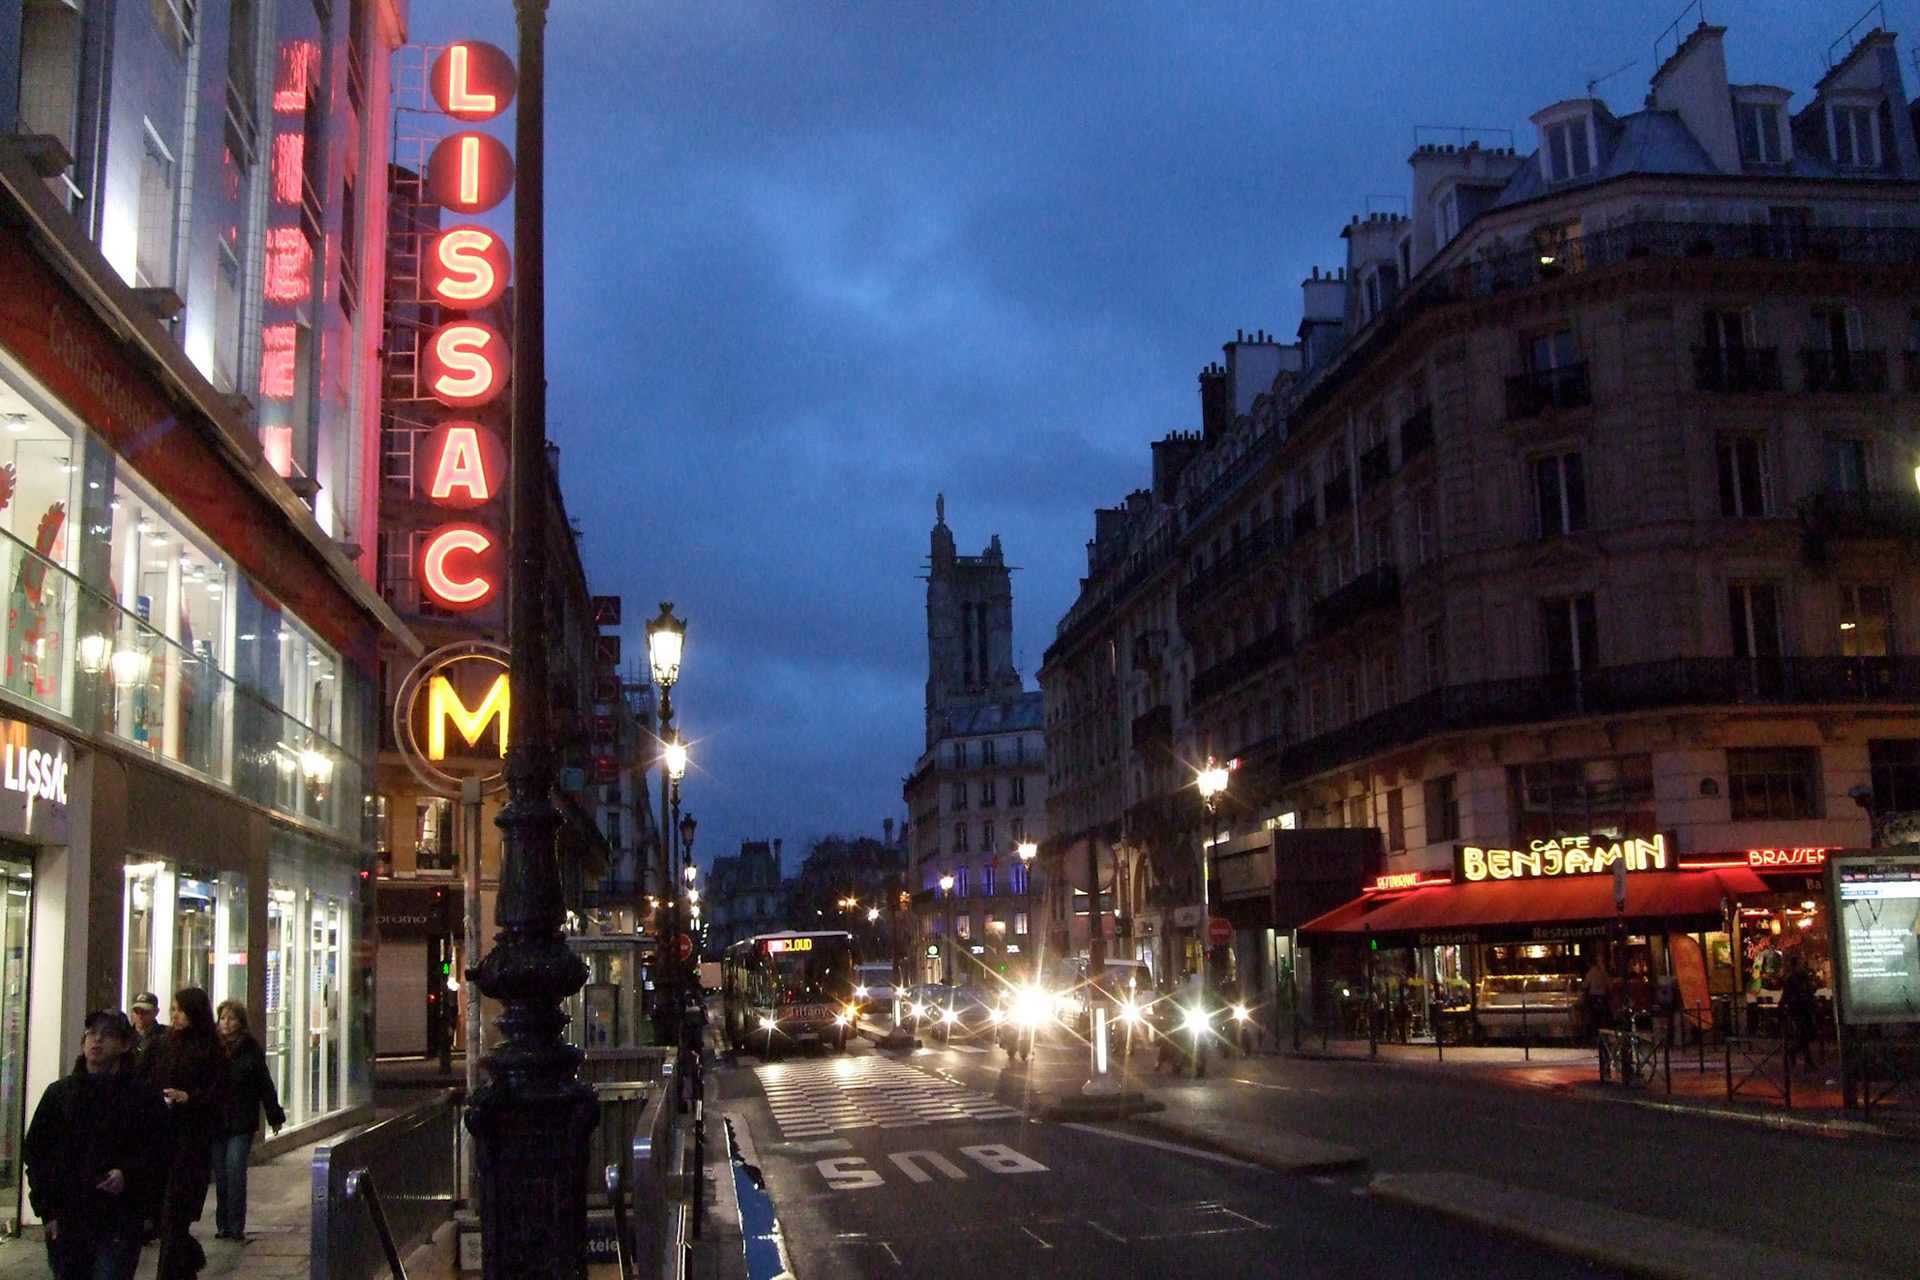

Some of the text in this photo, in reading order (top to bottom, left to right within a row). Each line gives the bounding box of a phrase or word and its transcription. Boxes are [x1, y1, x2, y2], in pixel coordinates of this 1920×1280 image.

[425, 45, 497, 603] LISSAC
[428, 673, 510, 761] M
[4, 743, 69, 806] LISSAC
[1464, 834, 1666, 881] BENJAMIN
[1530, 836, 1591, 852] CAFE
[1419, 925, 1606, 945] Brasserie Restaurant
[816, 1144, 1050, 1190] BUS
